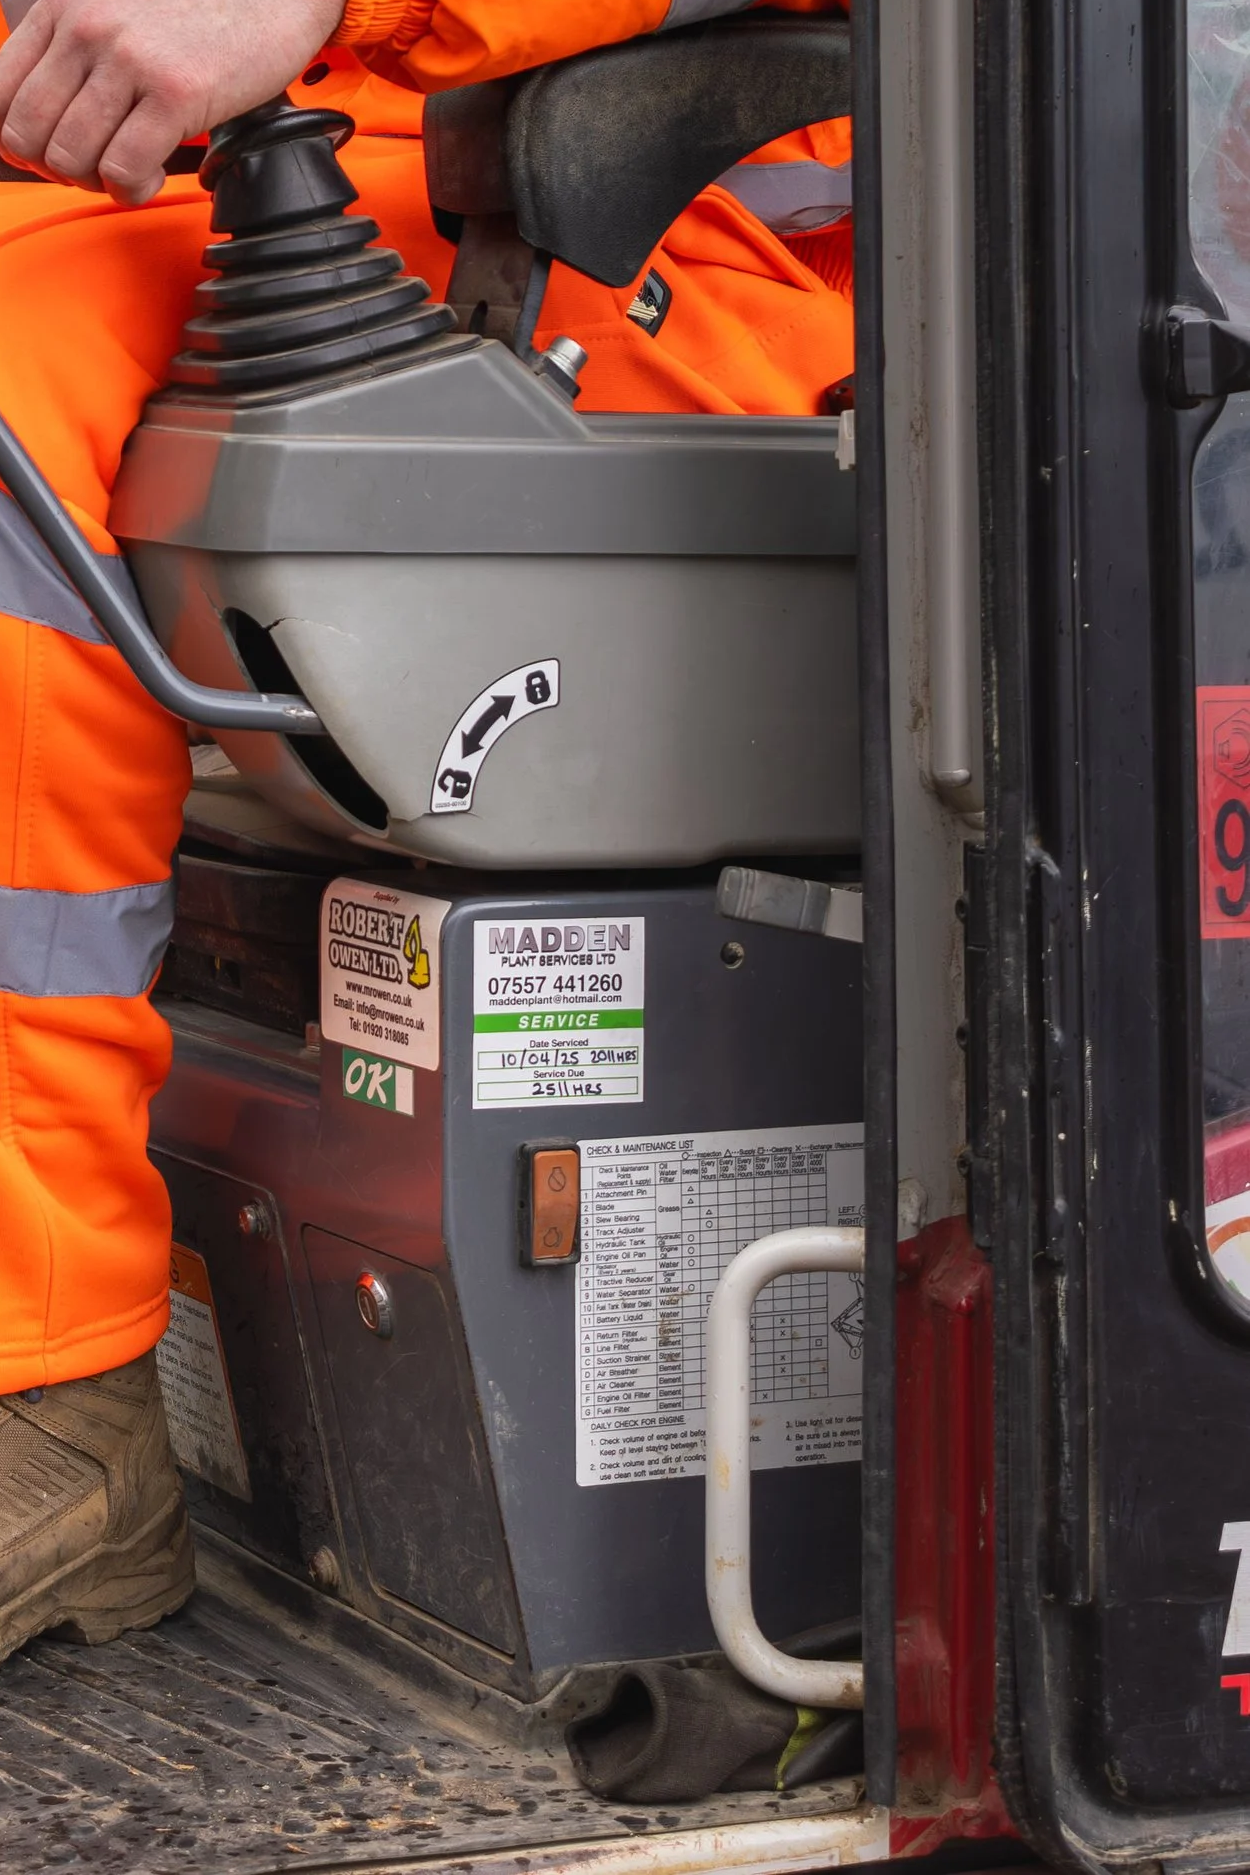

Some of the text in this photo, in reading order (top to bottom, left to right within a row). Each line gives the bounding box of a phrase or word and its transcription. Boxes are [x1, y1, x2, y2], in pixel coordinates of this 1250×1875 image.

[329, 898, 405, 950] ROBERT
[489, 924, 630, 954] MADDEN
[329, 938, 402, 985] OWEN LTD.
[502, 954, 616, 967] PLANT SERVICES LTD
[488, 974, 622, 995] 07557 441260
[346, 980, 412, 1007] www.mrowen.co.uk
[489, 994, 622, 1007] maddenplant@hotmail.com
[334, 994, 424, 1031] Email: info@mrowen.co.uk
[519, 1014, 599, 1029] SERVICE
[349, 1017, 409, 1045] Tel: 01920 318085
[530, 1038, 588, 1048] Date Serviced
[502, 1048, 579, 1069] 10/04/25
[533, 1070, 565, 1078] Service
[345, 1058, 393, 1104] OK
[587, 1140, 694, 1155] CHECK & MAINTENANCE LIST
[595, 1190, 633, 1198] Attachment
[617, 1227, 645, 1235] Adjuster
[596, 1253, 619, 1261] Engine
[619, 1288, 651, 1297] Separator
[597, 1314, 621, 1323] Battery
[624, 1313, 643, 1321] Liquid
[597, 1332, 619, 1340] Return
[597, 1357, 622, 1365] Suction
[610, 1368, 638, 1376] Breather
[659, 1364, 681, 1372] Element
[610, 1381, 635, 1389] Cleaner
[597, 1394, 620, 1403] Engine
[659, 1389, 681, 1397] Element
[614, 1420, 639, 1428] CHECK
[659, 1415, 685, 1423] ENGINE
[810, 1418, 822, 1426] light
[623, 1435, 645, 1443] volume
[656, 1432, 678, 1440] engine
[680, 1430, 688, 1438] oil
[646, 1443, 668, 1452] staying
[671, 1441, 697, 1450] between
[600, 1462, 620, 1470] Check
[623, 1460, 645, 1468] volume
[648, 1457, 659, 1465] and
[662, 1455, 672, 1463] dirt
[684, 1454, 706, 1462] cooling
[614, 1471, 631, 1479] clean
[634, 1469, 647, 1477] soft
[649, 1467, 666, 1476] water
[669, 1466, 678, 1474] for
